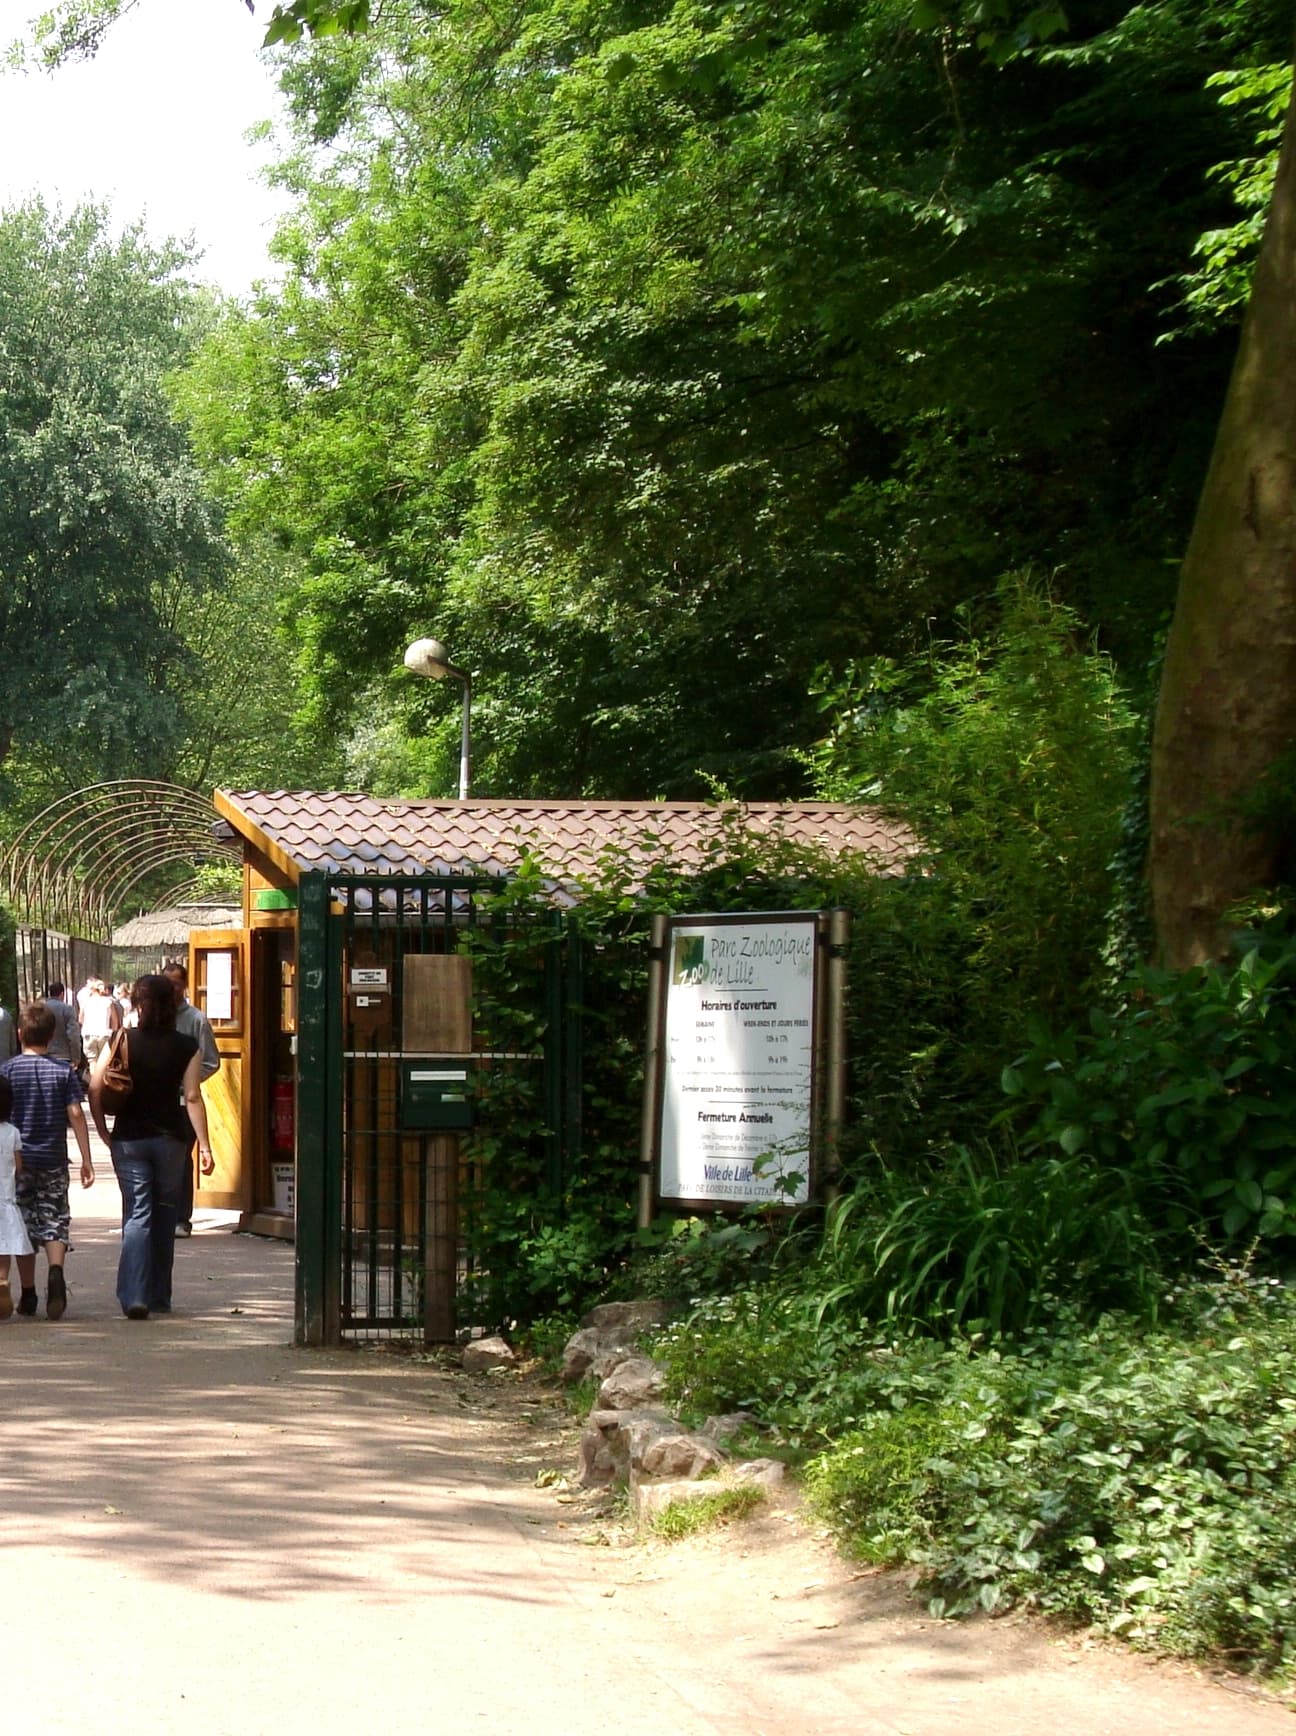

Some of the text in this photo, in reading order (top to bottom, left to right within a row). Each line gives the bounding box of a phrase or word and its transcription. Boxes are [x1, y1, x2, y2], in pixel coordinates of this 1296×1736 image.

[711, 931, 810, 965] Parc Zoologique
[711, 960, 754, 985] de Lille
[701, 1000, 777, 1011] Horaires d'ouverture
[697, 1111, 774, 1123] Fermeture Annuelle
[704, 1164, 752, 1181] Ville de Lille
